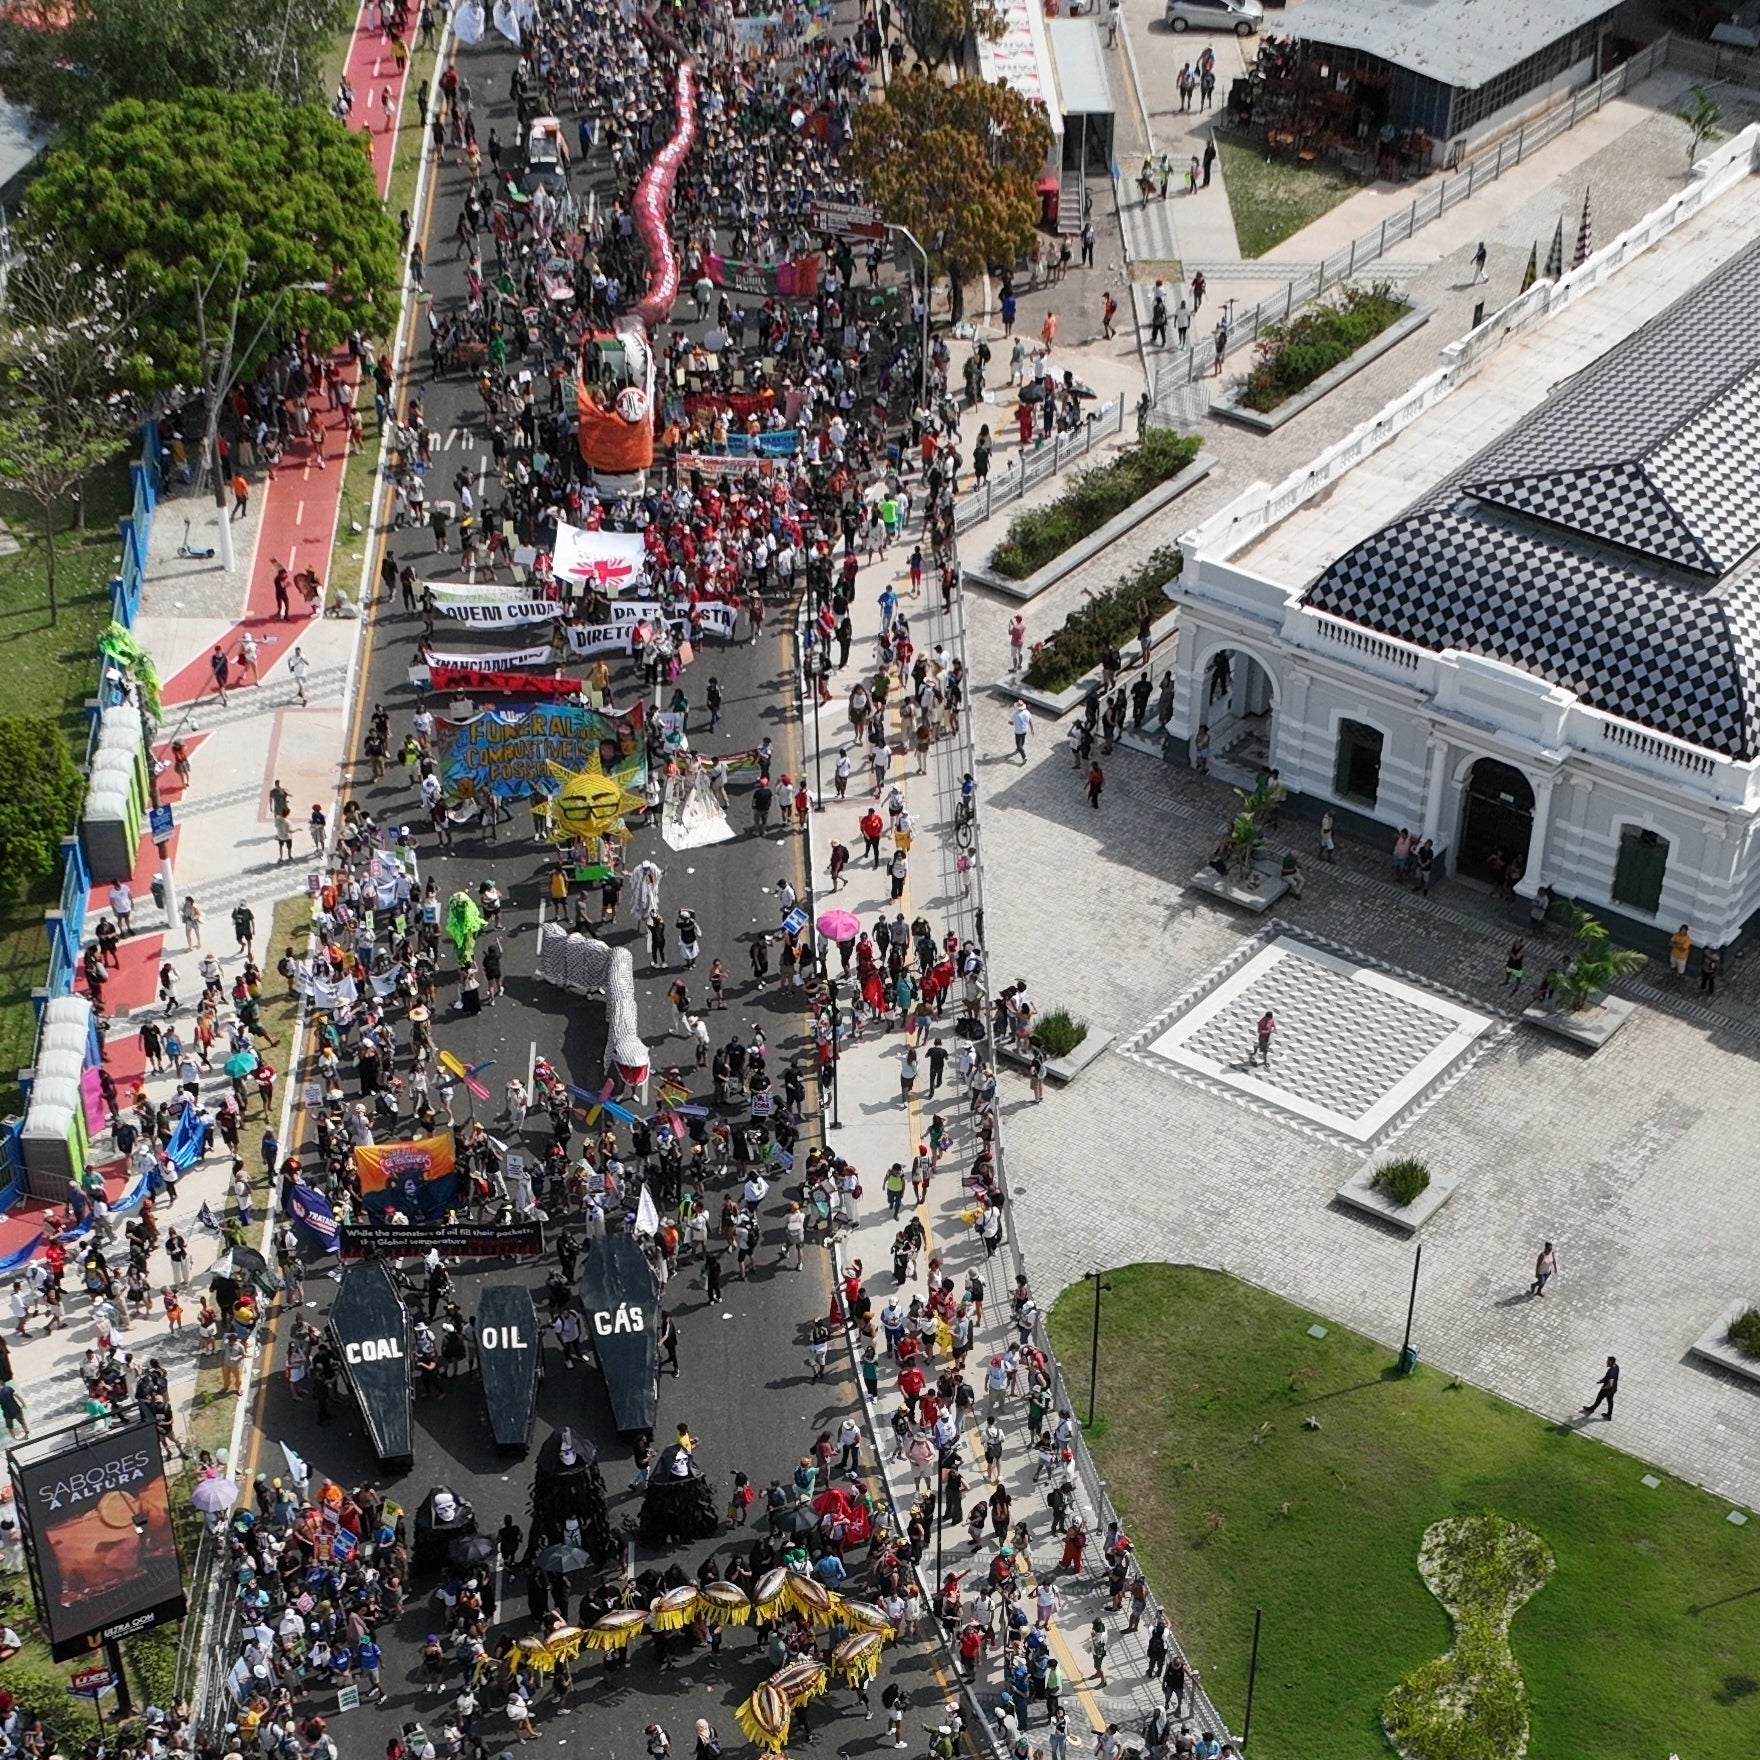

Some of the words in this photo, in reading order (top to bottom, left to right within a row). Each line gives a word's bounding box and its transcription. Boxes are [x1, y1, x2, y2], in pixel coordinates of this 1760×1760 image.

[446, 602, 502, 622] QUEM
[508, 600, 555, 618] CUIDA
[469, 714, 575, 745] FUNERAL
[308, 1211, 338, 1229] TRATADO
[346, 1229, 374, 1237] While
[375, 1229, 389, 1237] the
[435, 1229, 445, 1237] of
[447, 1228, 458, 1236] oil
[459, 1228, 472, 1236] fill
[473, 1229, 495, 1237] their
[377, 1238, 408, 1246] Global
[409, 1239, 467, 1247] temperature
[594, 1301, 644, 1337] GÁS
[482, 1325, 528, 1350] OIL
[345, 1337, 404, 1365] COAL
[38, 1450, 150, 1503] SABORES
[70, 1468, 144, 1504] ALTURA
[104, 1621, 131, 1638] ULTRA
